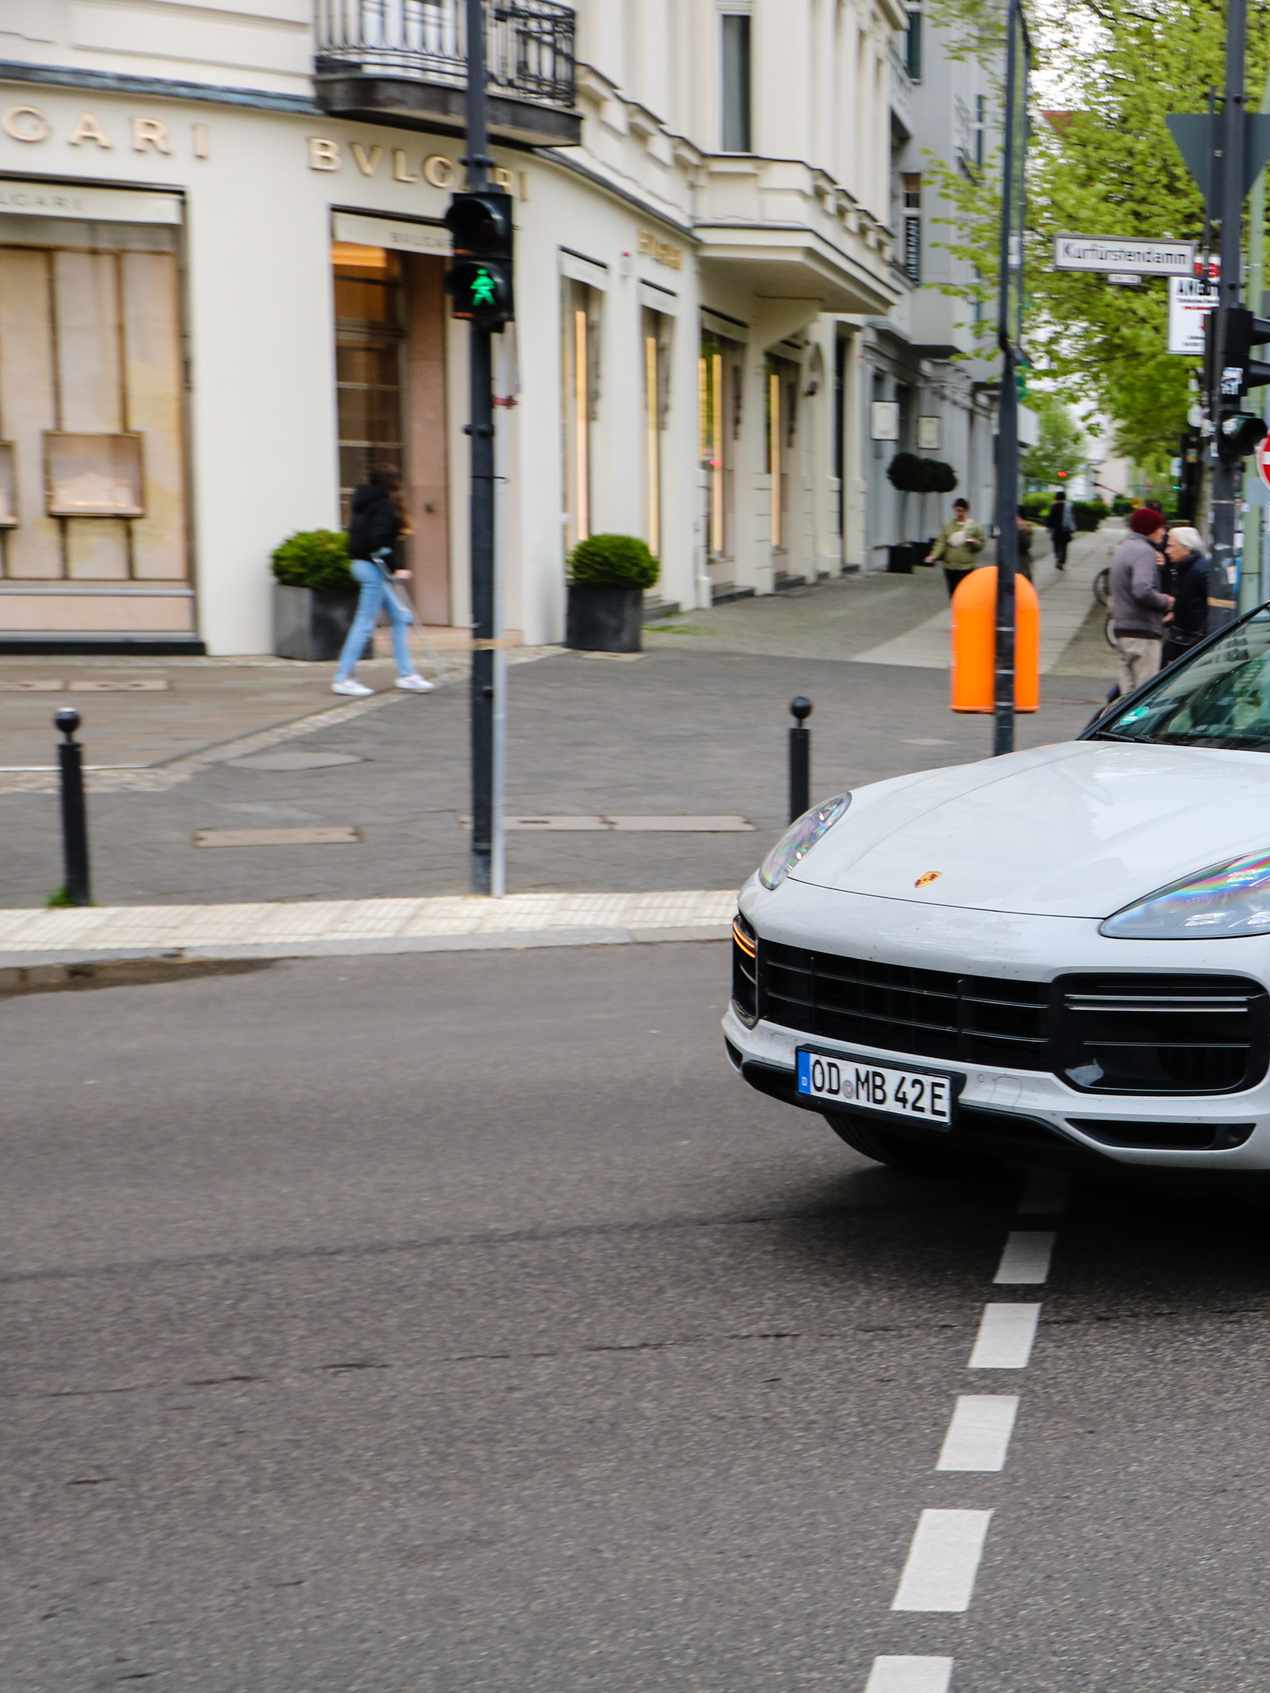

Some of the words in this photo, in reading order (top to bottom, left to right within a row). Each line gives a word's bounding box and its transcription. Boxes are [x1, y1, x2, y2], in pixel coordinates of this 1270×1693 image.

[306, 136, 530, 202] BVLGRI
[1062, 241, 1187, 265] Kurfürstendamm
[812, 1059, 841, 1095] OD
[855, 1067, 887, 1105] MB
[894, 1076, 947, 1117] 42E
